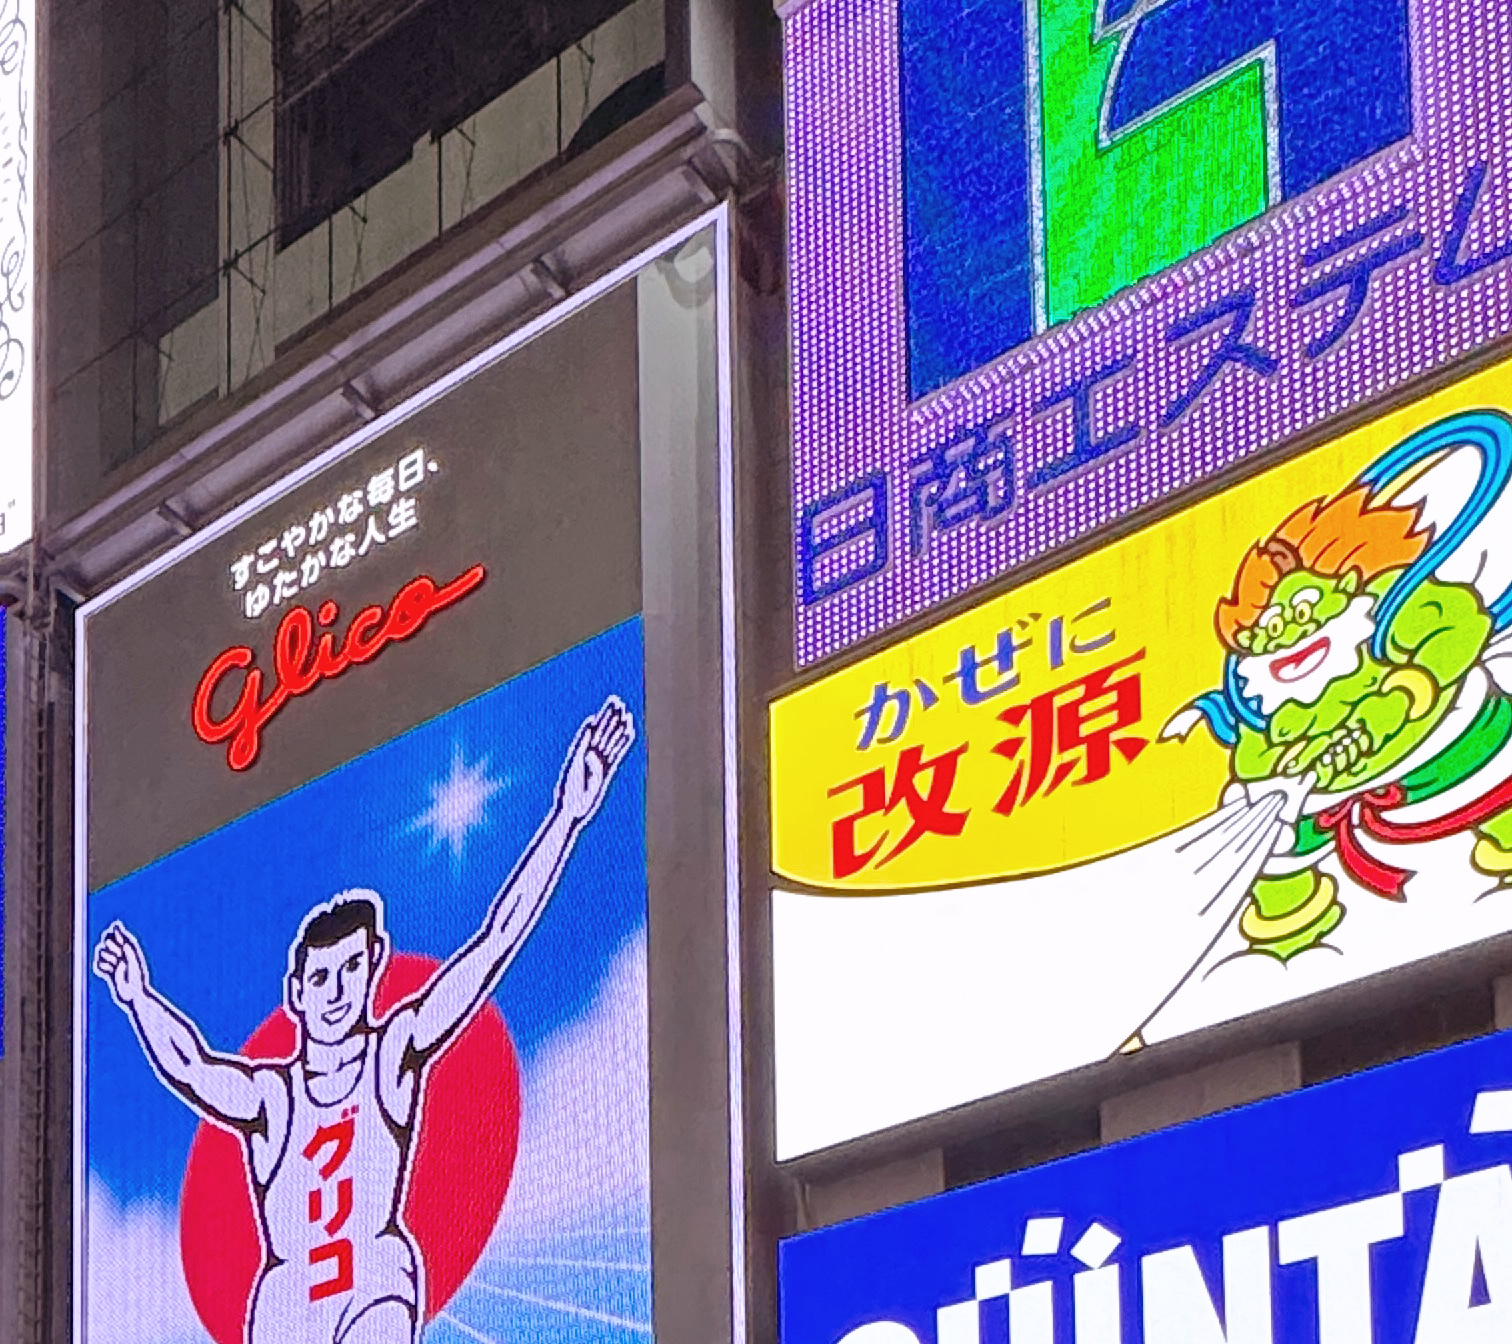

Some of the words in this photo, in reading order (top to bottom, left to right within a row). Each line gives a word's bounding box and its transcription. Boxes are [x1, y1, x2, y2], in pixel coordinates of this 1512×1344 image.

[243, 497, 418, 619] ゆたかな人生
[854, 597, 1117, 751] かぜに
[826, 647, 1156, 880] 改源
[302, 1103, 360, 1304] グリコ
